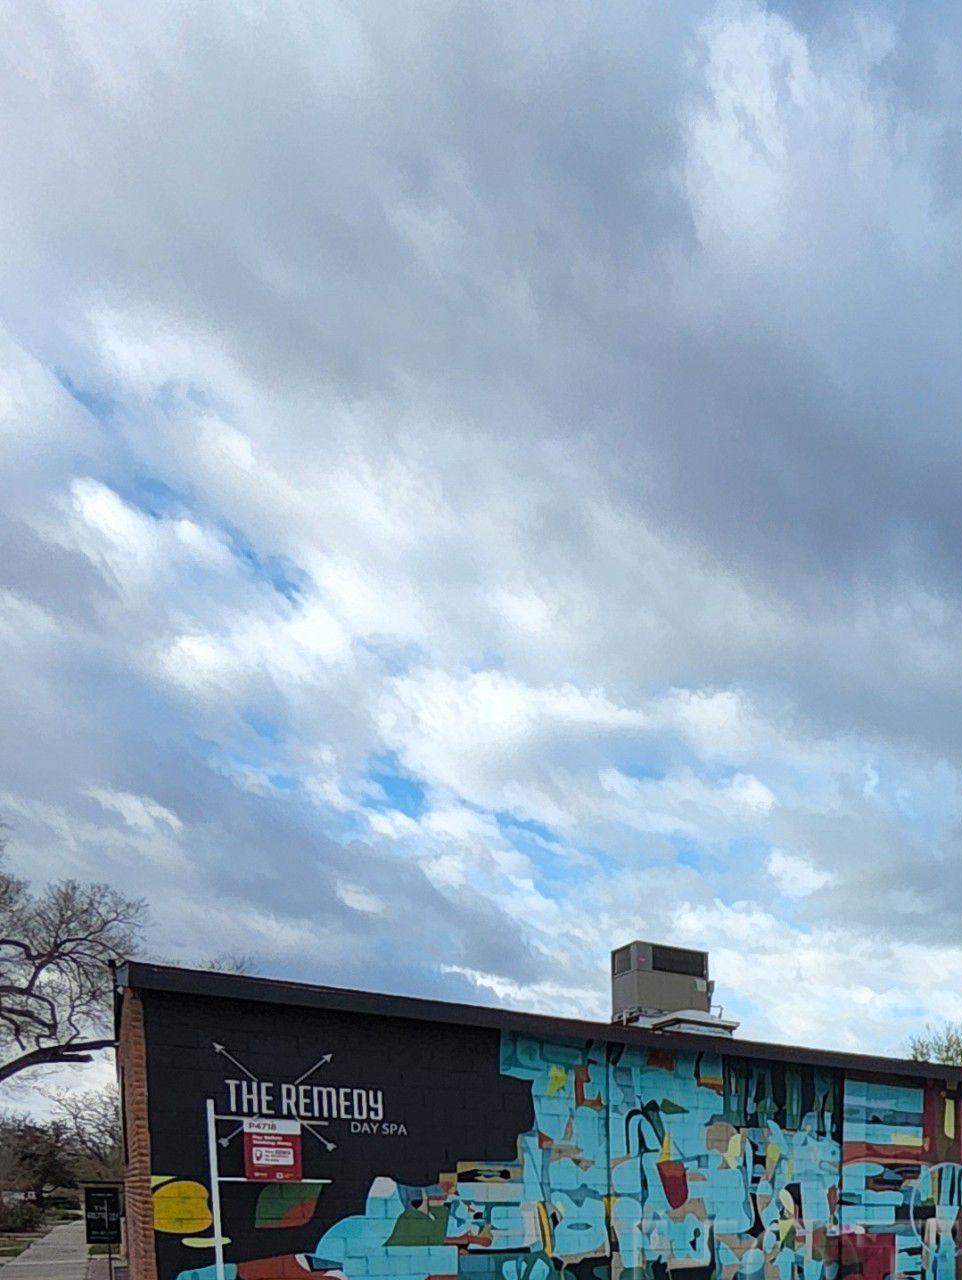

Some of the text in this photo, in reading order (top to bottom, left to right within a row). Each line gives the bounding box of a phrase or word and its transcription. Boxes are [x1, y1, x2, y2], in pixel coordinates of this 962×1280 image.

[224, 1079, 384, 1120] THE REMEDY
[351, 1122, 408, 1135] DAY SPA
